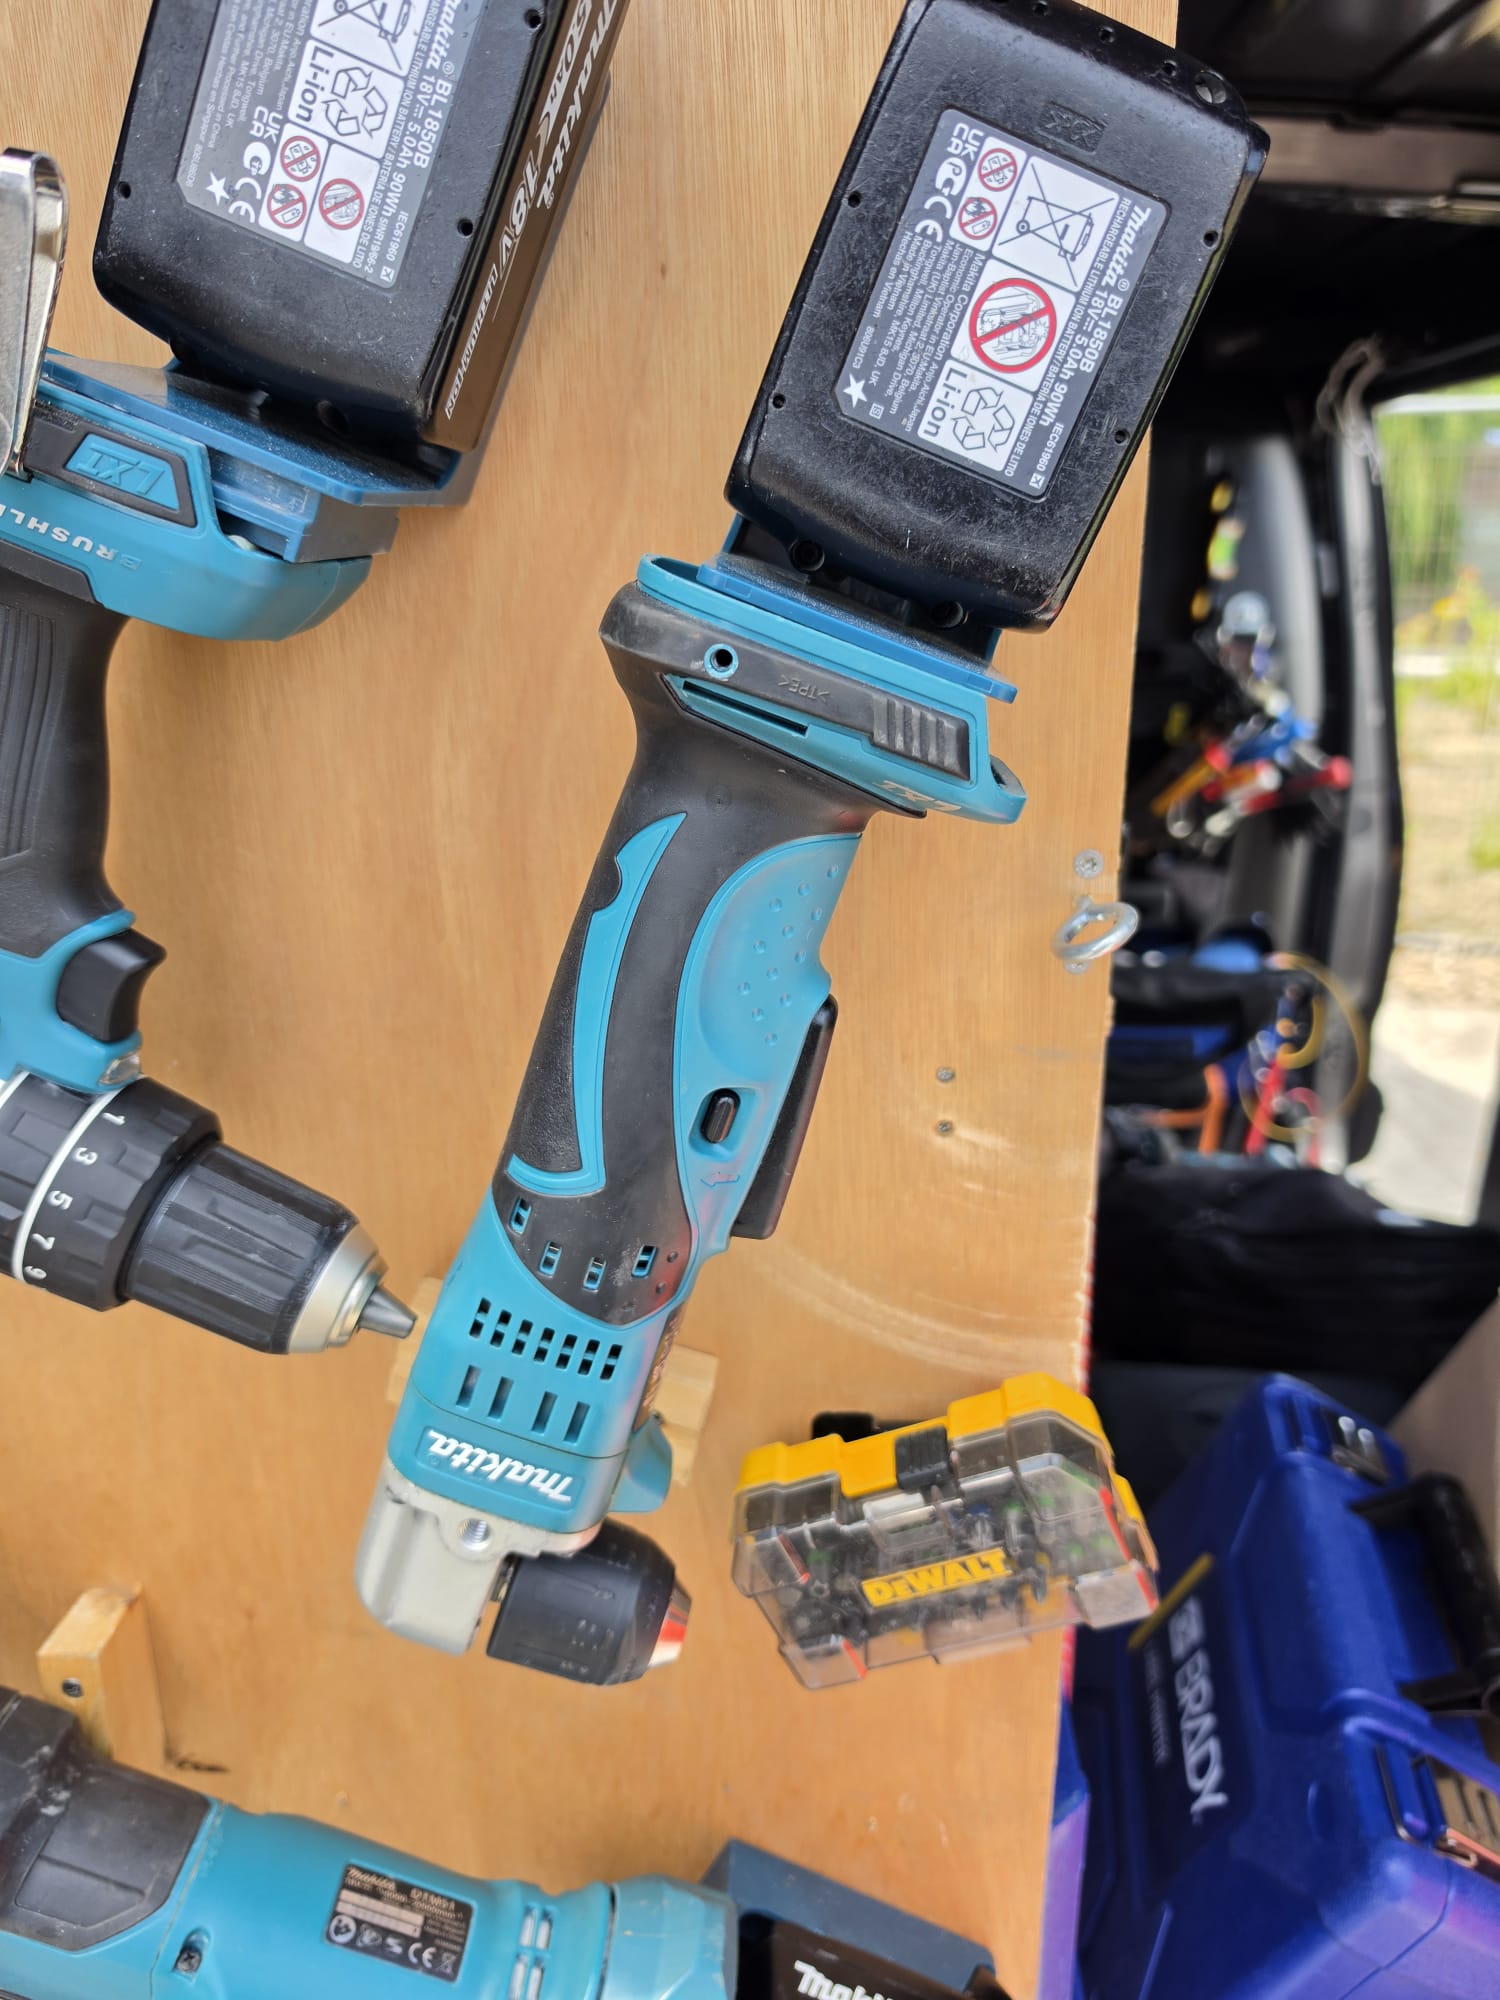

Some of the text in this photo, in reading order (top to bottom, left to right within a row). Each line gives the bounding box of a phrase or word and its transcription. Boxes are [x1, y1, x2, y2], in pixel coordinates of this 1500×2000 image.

[294, 45, 334, 124] Li-ion
[405, 51, 425, 89] LITHIUM
[400, 89, 413, 107] ION
[247, 104, 269, 137] CA
[261, 111, 283, 143] UK
[411, 78, 452, 168] BL1850B
[944, 121, 970, 156] CA
[395, 121, 422, 169] 5.0Ah
[958, 126, 985, 163] UK
[371, 190, 383, 205] DE
[381, 171, 407, 218] 90Wh
[359, 231, 370, 245] DE
[363, 204, 379, 232] IONES
[385, 210, 408, 261] IEC61960
[1092, 196, 1131, 270] RECHARGEABLE
[351, 245, 366, 269] LITIO
[890, 230, 913, 267] Hechas
[934, 238, 955, 272] Makita
[1099, 201, 1152, 291] makita
[884, 234, 923, 311] Made in Vietnam
[886, 265, 897, 280] en
[890, 238, 934, 319] Buckinghamshire,
[924, 270, 942, 294] (UK)
[934, 242, 965, 296] Jan-Baptist
[947, 247, 974, 294] Economic
[960, 251, 986, 293] Makita
[1077, 268, 1101, 306] LITHIUM
[869, 279, 894, 319] Vietnam
[889, 242, 942, 354] Tongwell, Milton Keynes,
[917, 294, 944, 342] Vinkstraat
[930, 292, 955, 334] Operator
[1070, 303, 1086, 322] ION
[881, 318, 901, 348] MK15
[927, 334, 939, 345] in
[929, 292, 969, 362] Corporation
[1076, 292, 1123, 375] BL1850B
[892, 329, 919, 372] Michigan
[1057, 332, 1089, 382] 5.0Ah
[866, 368, 881, 387] UK
[883, 370, 902, 399] Drive,
[886, 377, 910, 416] Belgium
[922, 367, 968, 440] Li-ion
[1029, 400, 1043, 416] DE
[1037, 380, 1069, 429] 90Wh
[1012, 441, 1026, 456] DE
[1018, 414, 1038, 443] IONES
[1034, 421, 1064, 473] IEC61960
[73, 442, 164, 497] LXT
[1003, 454, 1020, 477] LITIO
[22, 1106, 127, 1282] 1 3 5 7 9
[427, 1429, 572, 1502] makita
[1171, 1647, 1229, 1813] BRADY
